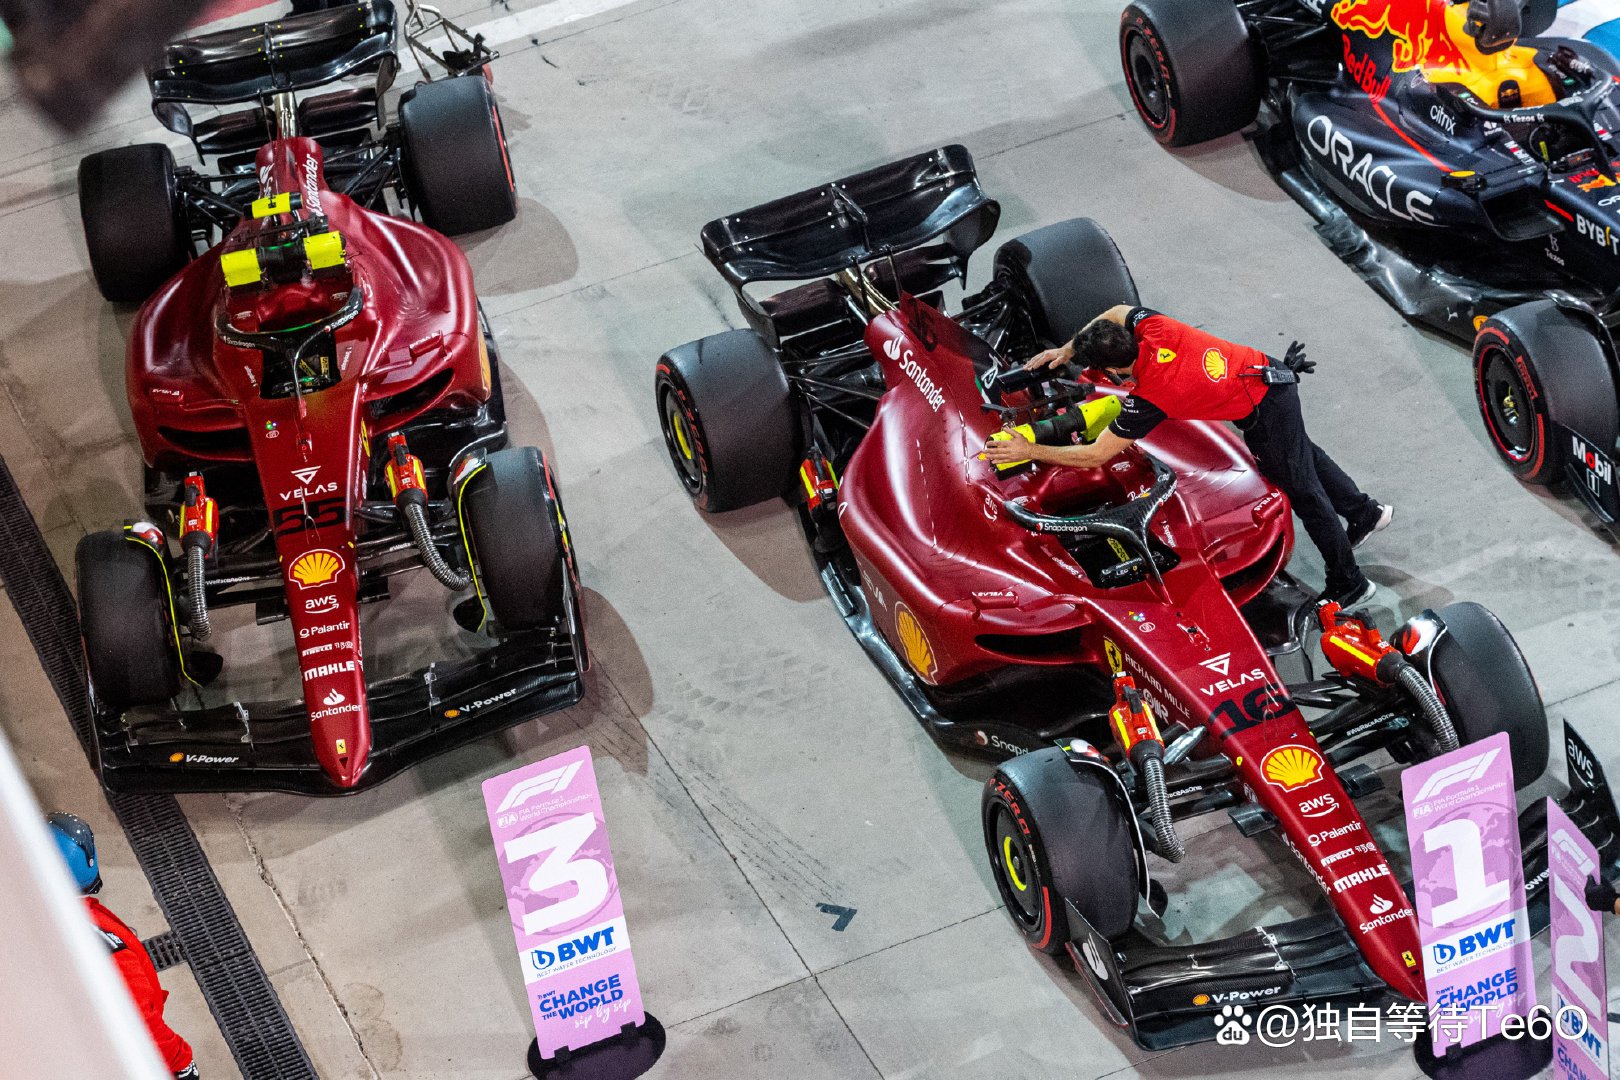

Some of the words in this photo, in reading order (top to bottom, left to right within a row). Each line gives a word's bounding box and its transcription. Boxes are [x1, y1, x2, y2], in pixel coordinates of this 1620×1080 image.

[1342, 33, 1368, 83] Red
[1361, 58, 1393, 104] Bull
[1430, 105, 1457, 136] citrix
[1511, 114, 1536, 123] Tezos
[1307, 115, 1449, 228] ORACLE
[1576, 213, 1619, 256] BYBIT
[899, 349, 946, 413] Santander
[1572, 435, 1612, 486] Mobil
[280, 482, 338, 501] VELAS
[273, 497, 349, 537] 55
[1044, 522, 1088, 532] Snapdragon
[305, 594, 338, 609] aws
[311, 620, 351, 636] Palantir
[304, 660, 355, 682] MAHLE
[1125, 652, 1163, 696] RICHARD
[1163, 688, 1190, 719] MILLE
[1200, 668, 1265, 697] VELAS
[310, 703, 363, 722] Santander
[459, 688, 517, 713] V-Power
[1209, 683, 1299, 739] 16
[1346, 711, 1395, 737] #WeRaceAsOne
[185, 754, 239, 764] V-Power
[1568, 737, 1595, 780] aws
[997, 781, 1031, 836] ZERO
[1298, 793, 1336, 813] aws
[1320, 820, 1362, 842] Palantir
[504, 811, 608, 936] 3
[1333, 862, 1391, 894] MAHLE
[1424, 818, 1511, 929] 1
[1359, 907, 1414, 935] Santander
[557, 926, 615, 962] BWT
[1459, 918, 1516, 957] BWT
[539, 973, 621, 1013] CHANGE
[1212, 984, 1282, 1004] V-Power
[1436, 967, 1518, 1009] CHANGE
[1456, 982, 1519, 1016] WORLD
[541, 1011, 558, 1021] THE
[557, 989, 624, 1020] WORLD
[574, 1014, 593, 1029] sip
[596, 1003, 610, 1023] by
[613, 998, 631, 1013] sip
